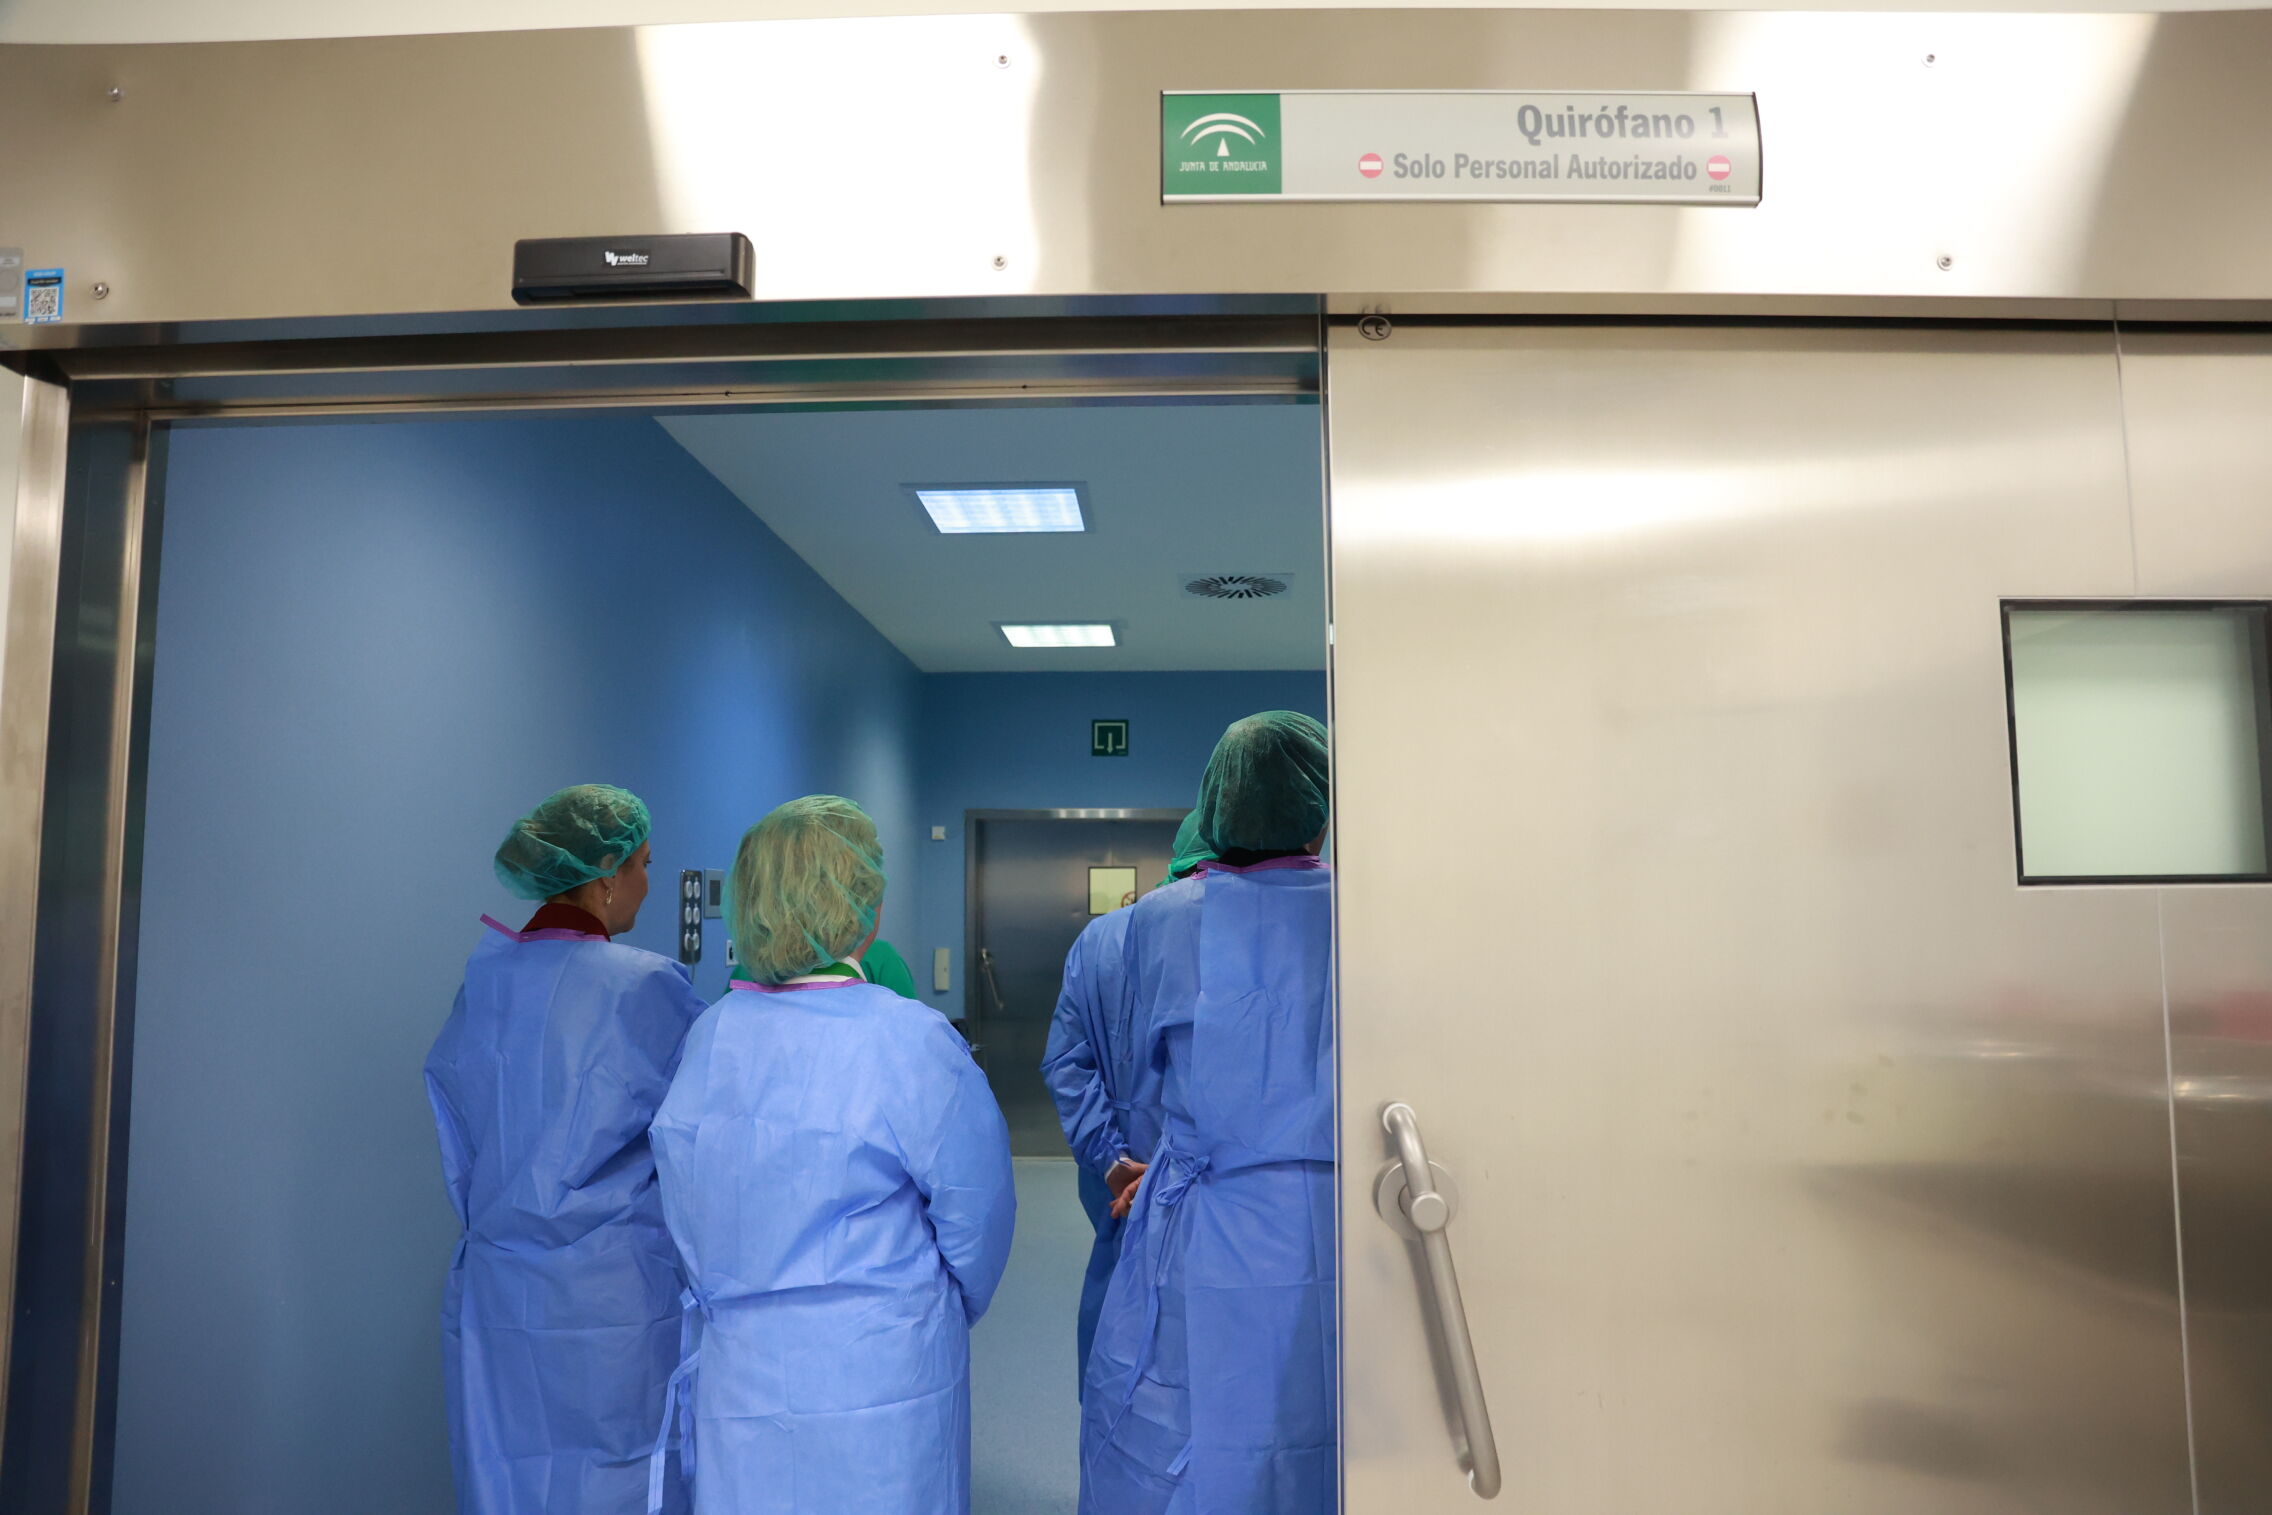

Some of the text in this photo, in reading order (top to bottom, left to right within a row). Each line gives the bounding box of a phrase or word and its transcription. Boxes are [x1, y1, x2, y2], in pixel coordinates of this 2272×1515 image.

[1517, 104, 1729, 146] Quirófano 1
[1179, 161, 1205, 171] JUNTA
[1209, 161, 1219, 171] DE
[1393, 152, 1698, 180] Solo Personal Autorizado
